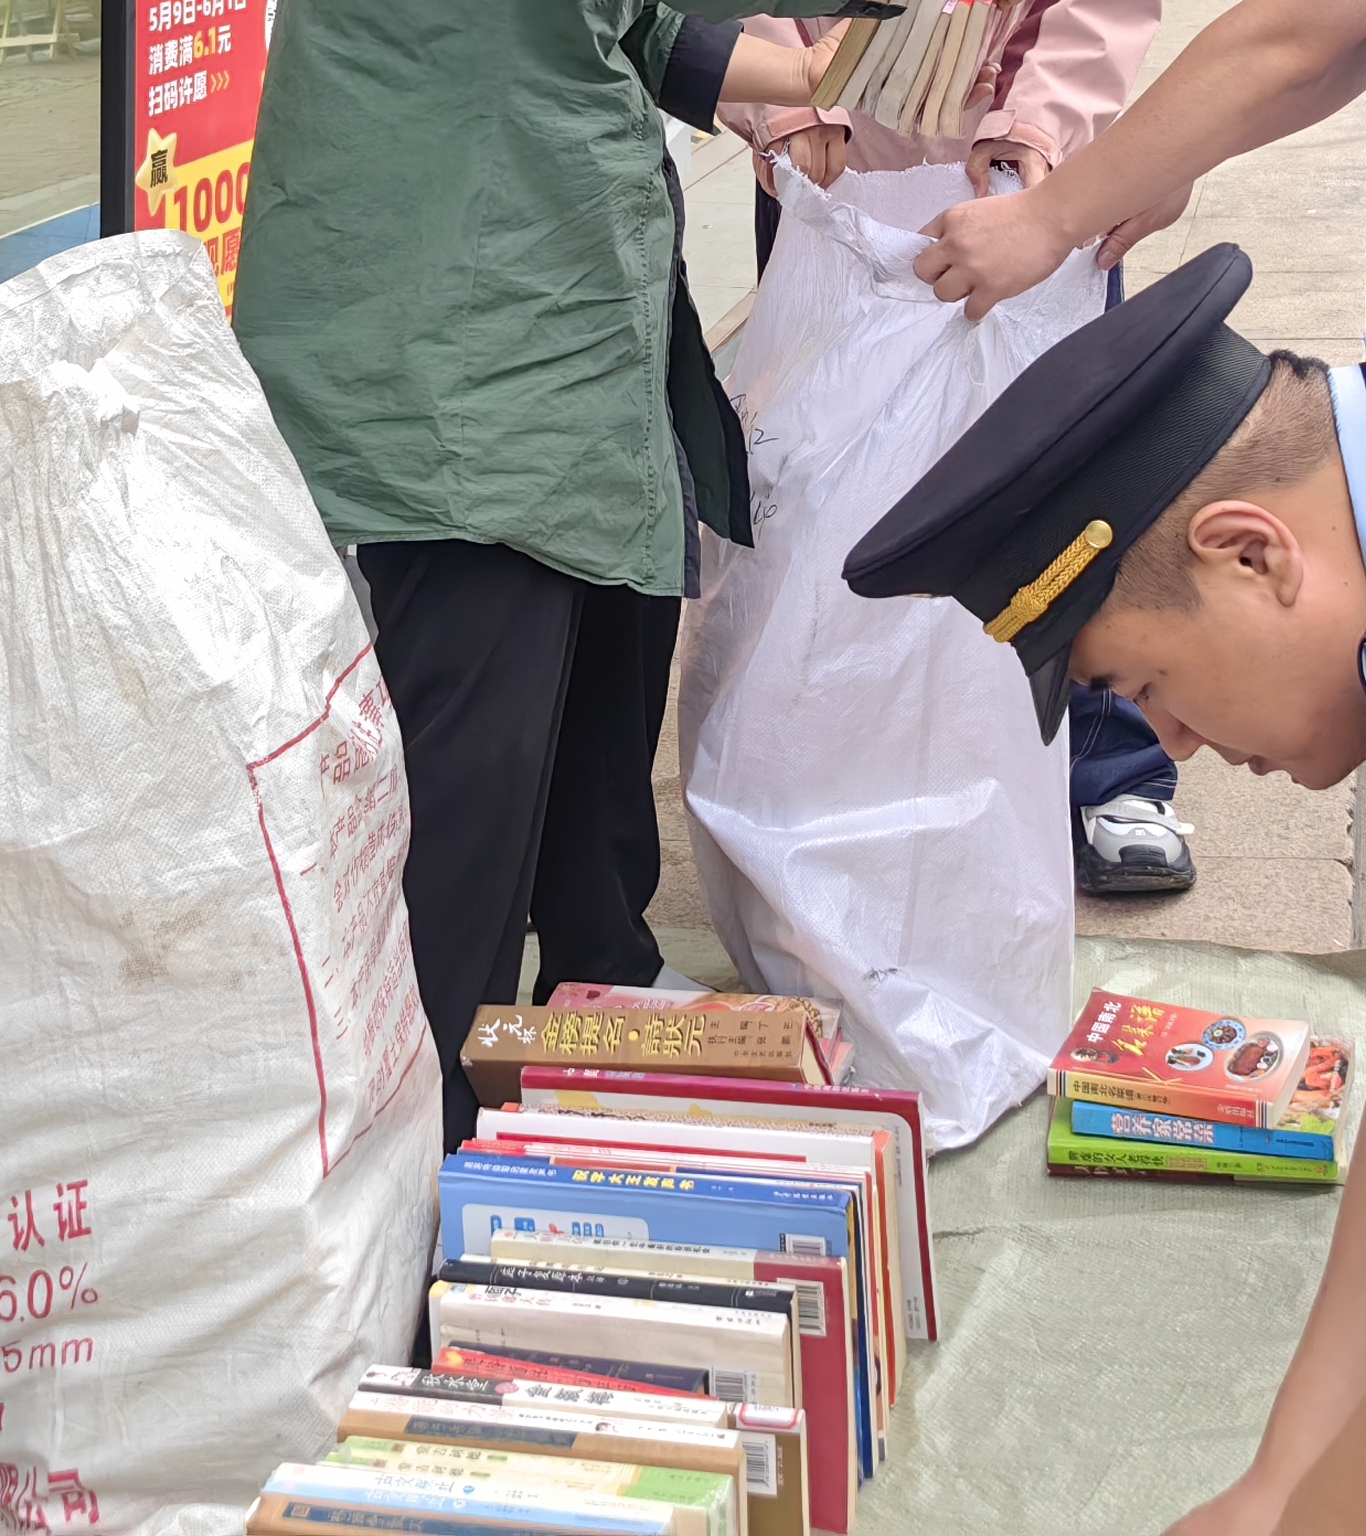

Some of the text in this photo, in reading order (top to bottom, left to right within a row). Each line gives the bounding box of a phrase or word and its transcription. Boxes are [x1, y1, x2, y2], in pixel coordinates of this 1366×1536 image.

[149, 24, 232, 76] 消费满6.1元
[149, 70, 208, 117] 扫码许愿
[150, 148, 169, 189] 赢
[1085, 1000, 1123, 1044] 中国南北
[1111, 1112, 1215, 1145] 营养家常菜
